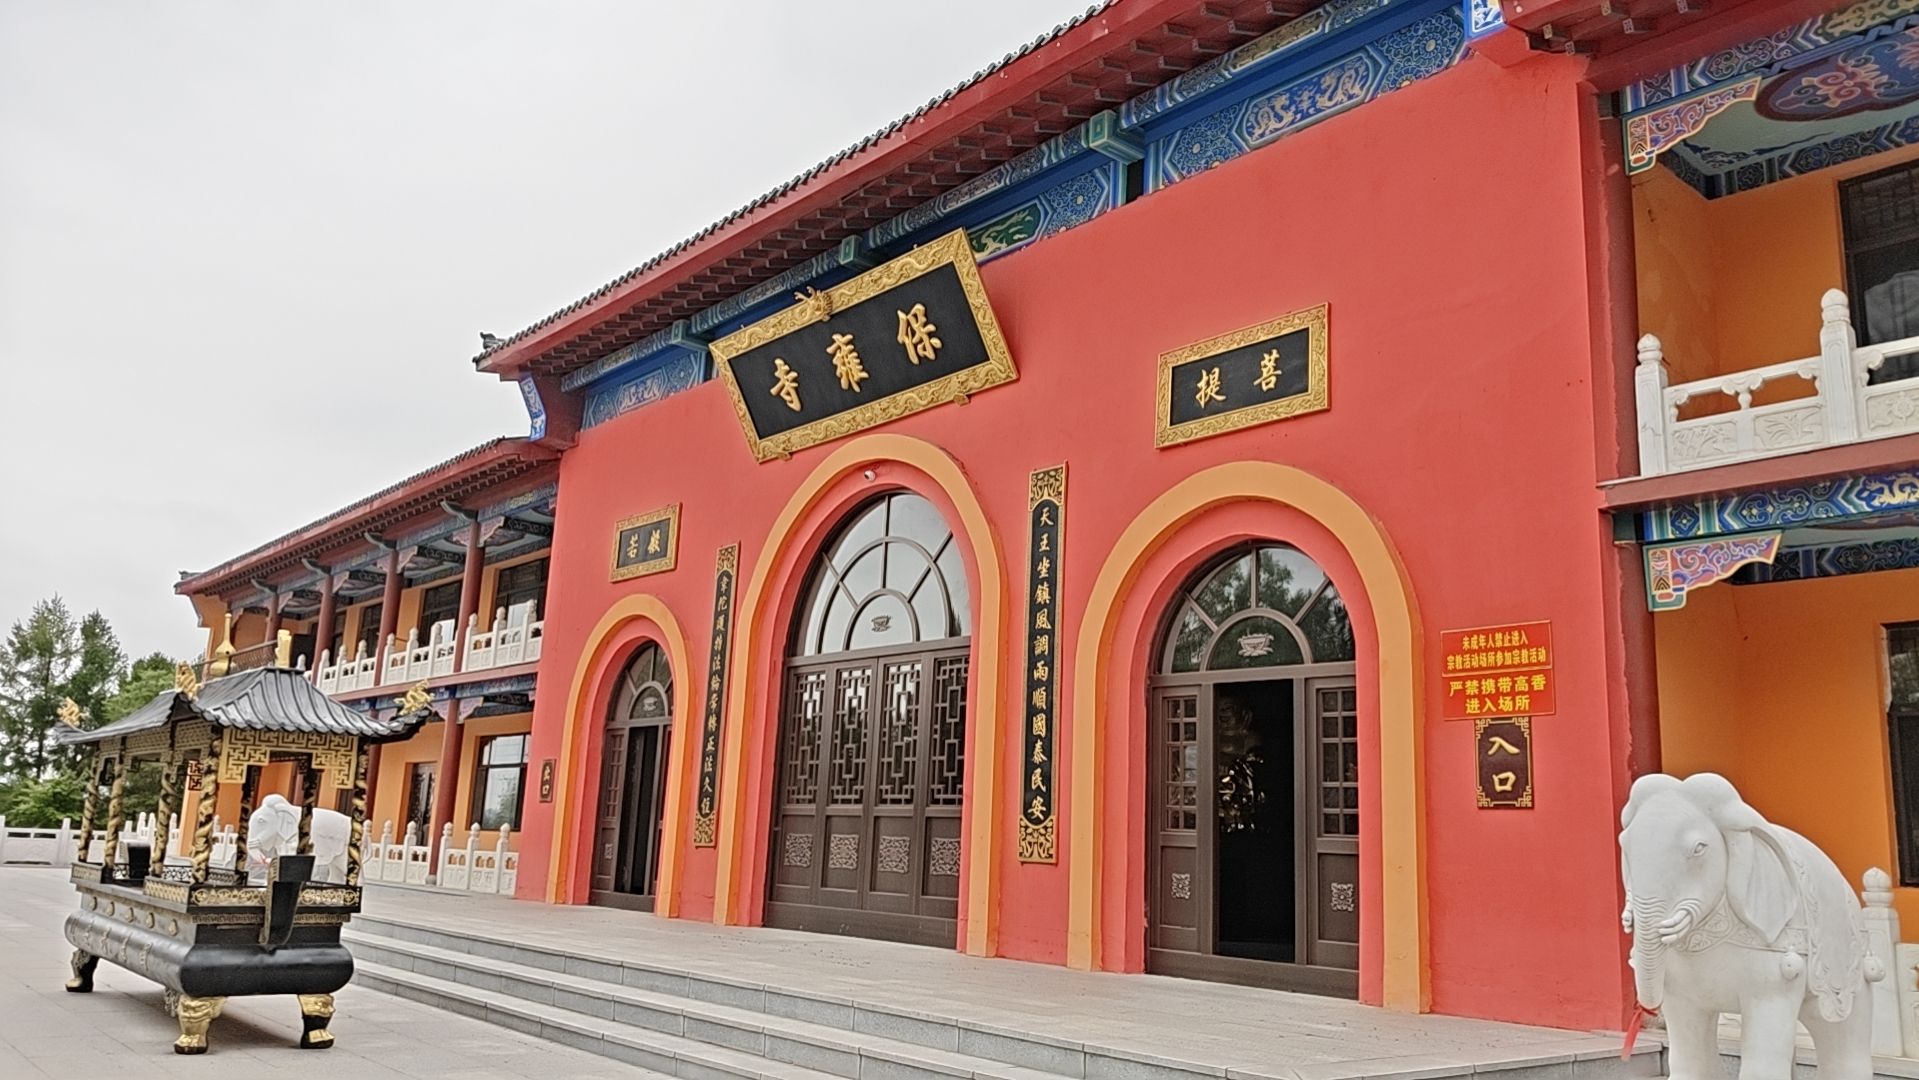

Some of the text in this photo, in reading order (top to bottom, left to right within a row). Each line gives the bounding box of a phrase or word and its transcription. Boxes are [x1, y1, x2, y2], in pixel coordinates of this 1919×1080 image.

[1195, 349, 1282, 409] 菩提
[1462, 630, 1528, 650] 未成年人禁止进入
[1027, 507, 1054, 821] 天王坐鎮風調雨順國泰民安
[1447, 647, 1545, 670] 宗教活动场所参加宗教活动
[1450, 674, 1545, 696] 严禁携带高香
[1466, 695, 1530, 714] 进入场所
[1488, 736, 1520, 792] 入口
